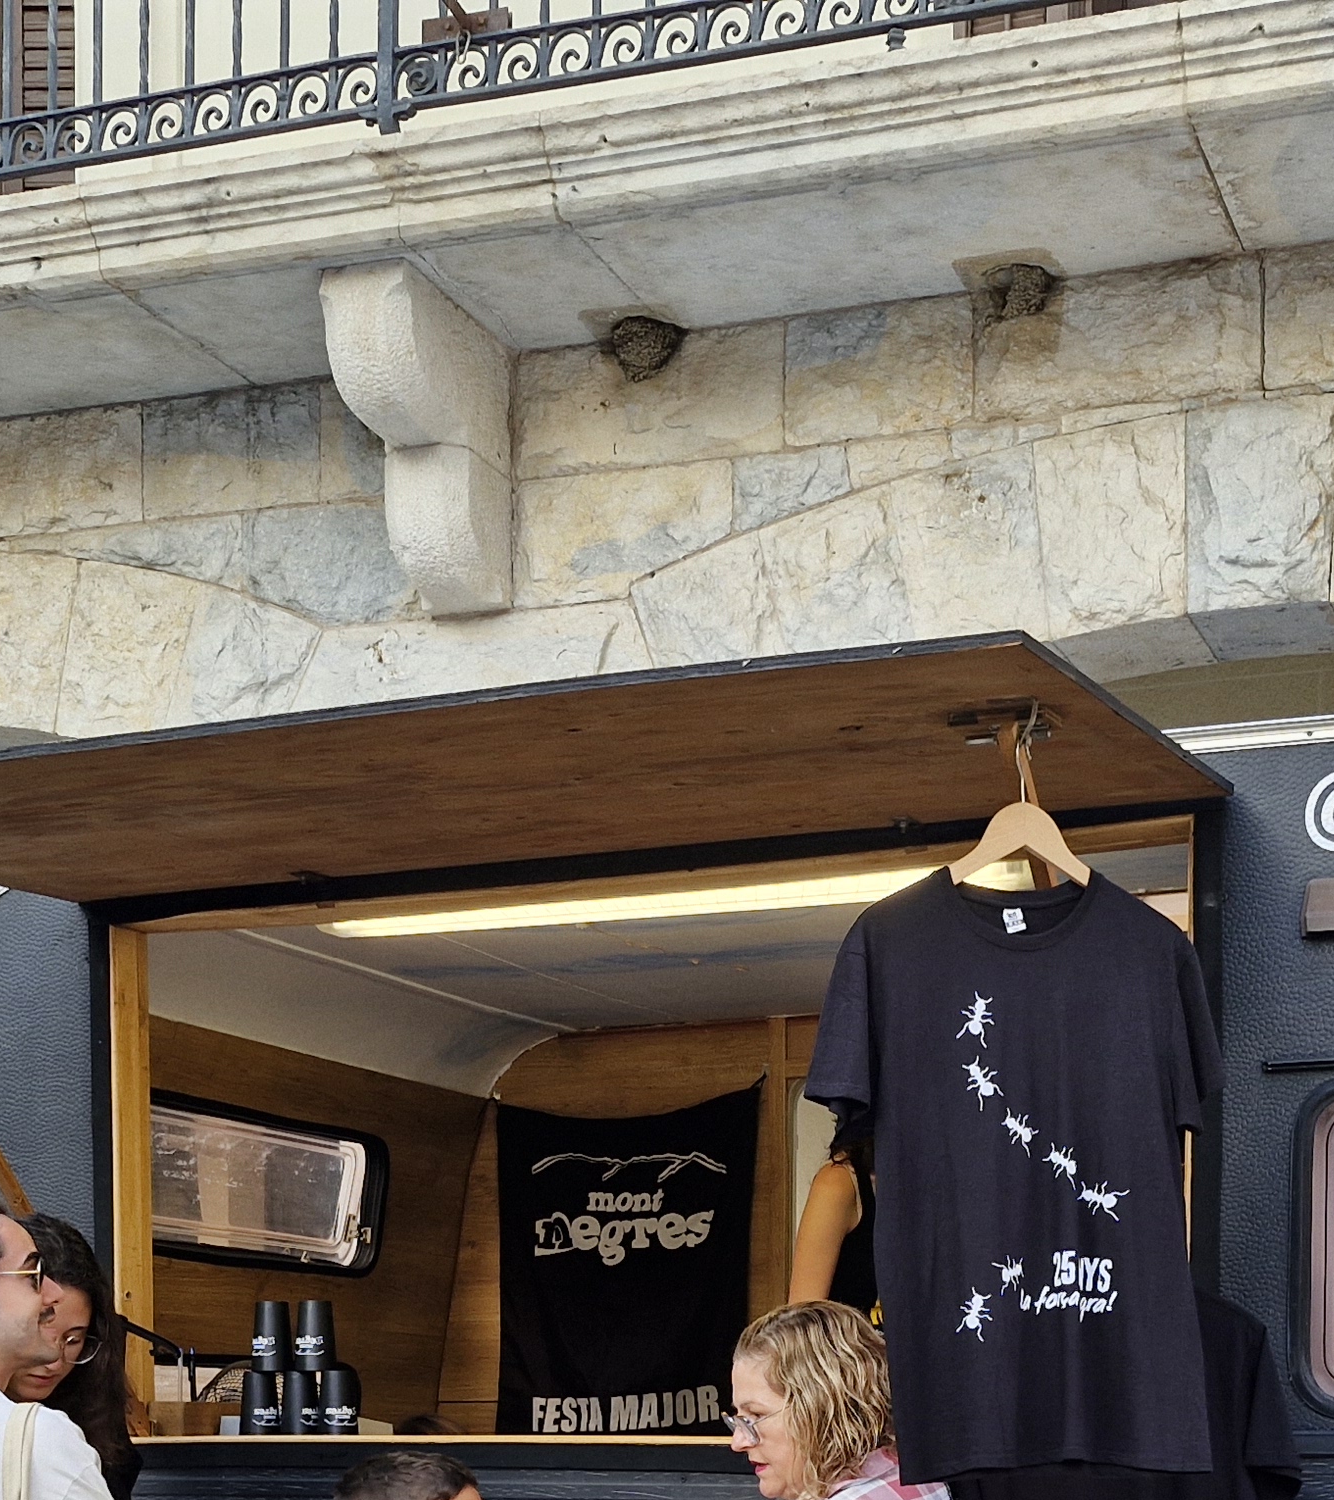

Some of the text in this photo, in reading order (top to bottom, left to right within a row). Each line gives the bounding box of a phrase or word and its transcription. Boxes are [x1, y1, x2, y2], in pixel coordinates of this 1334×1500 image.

[586, 1188, 665, 1212] mont
[534, 1210, 715, 1266] negres
[532, 1385, 720, 1433] FESTA MAJOR
